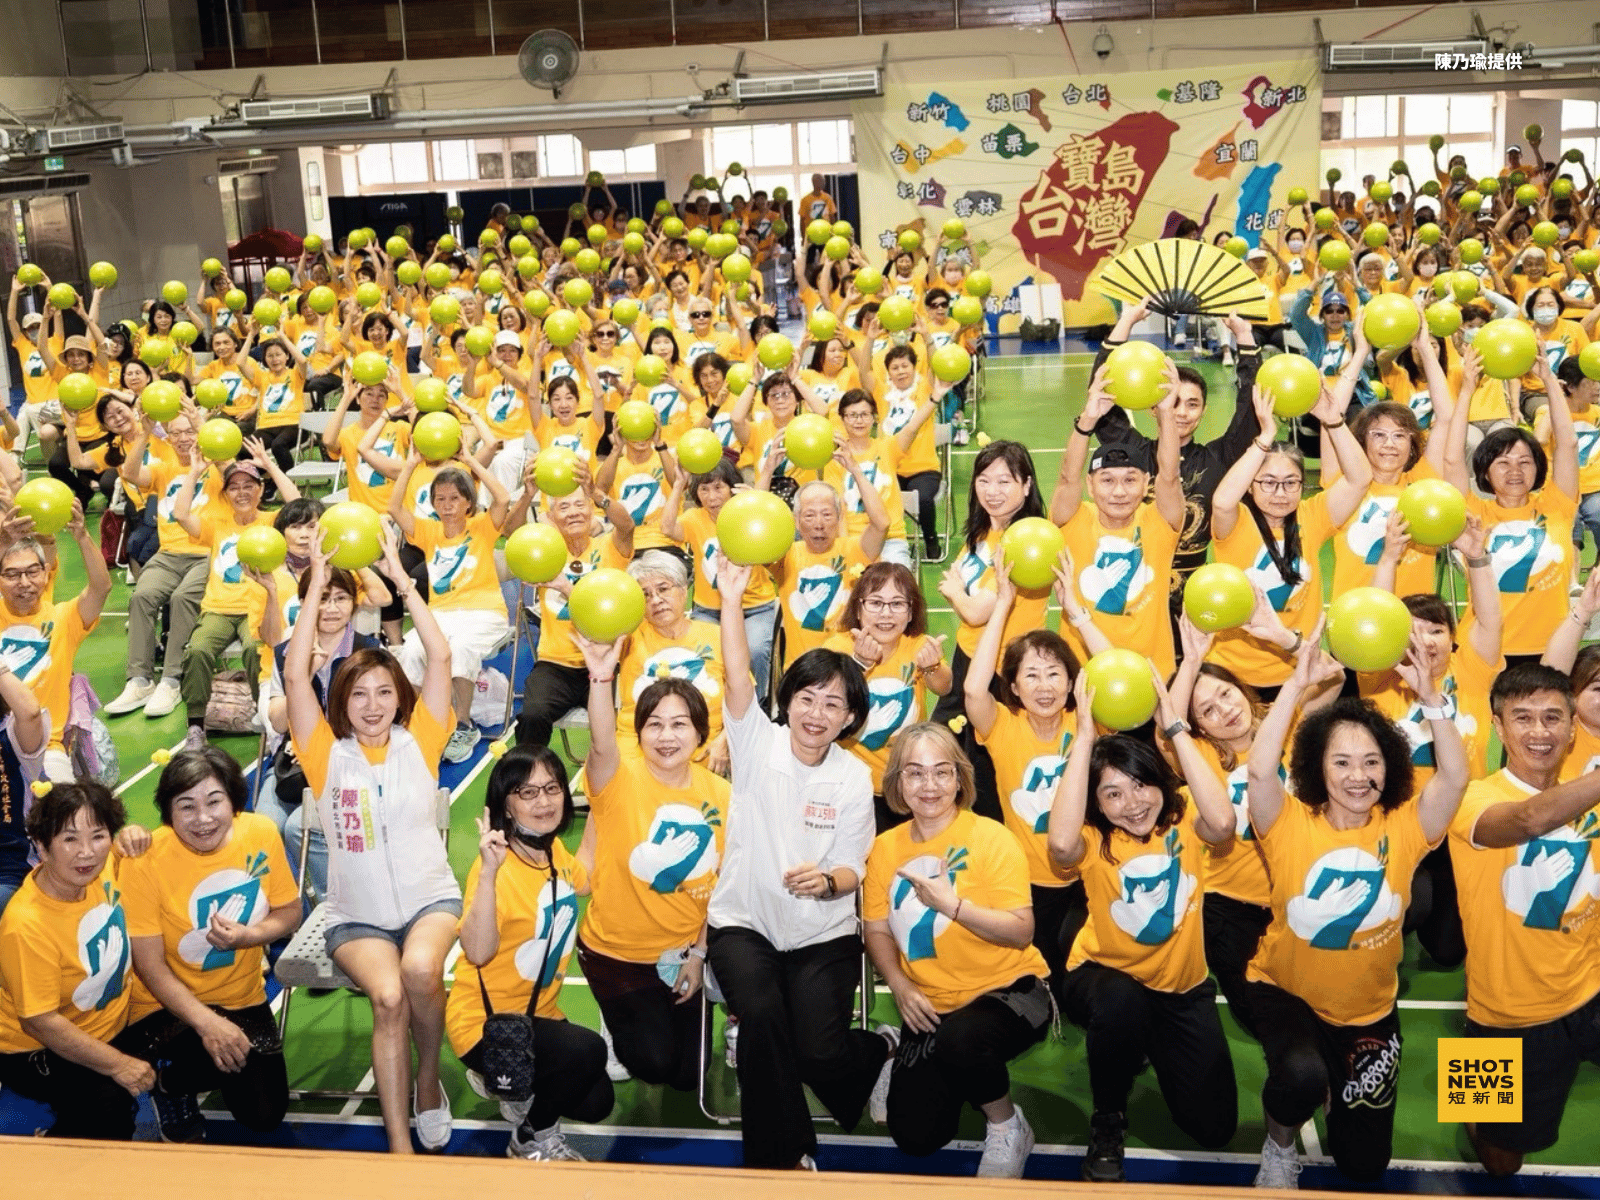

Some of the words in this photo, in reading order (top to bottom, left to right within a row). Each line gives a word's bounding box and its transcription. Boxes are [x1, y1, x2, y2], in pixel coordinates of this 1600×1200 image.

[986, 91, 1031, 113] 桃園
[1062, 83, 1107, 105] 台北
[1174, 80, 1222, 104] 基隆
[1261, 85, 1306, 108] 新北
[907, 103, 951, 123] 新竹
[890, 144, 932, 165] 台中
[980, 133, 1024, 154] 苗栗
[1215, 139, 1258, 164] 宜蘭
[1054, 134, 1145, 195] 寶島
[897, 181, 938, 200] 彰化
[953, 198, 1001, 217] 雲林
[1021, 169, 1133, 258] 台灣
[341, 789, 364, 852] 陳乃瑜
